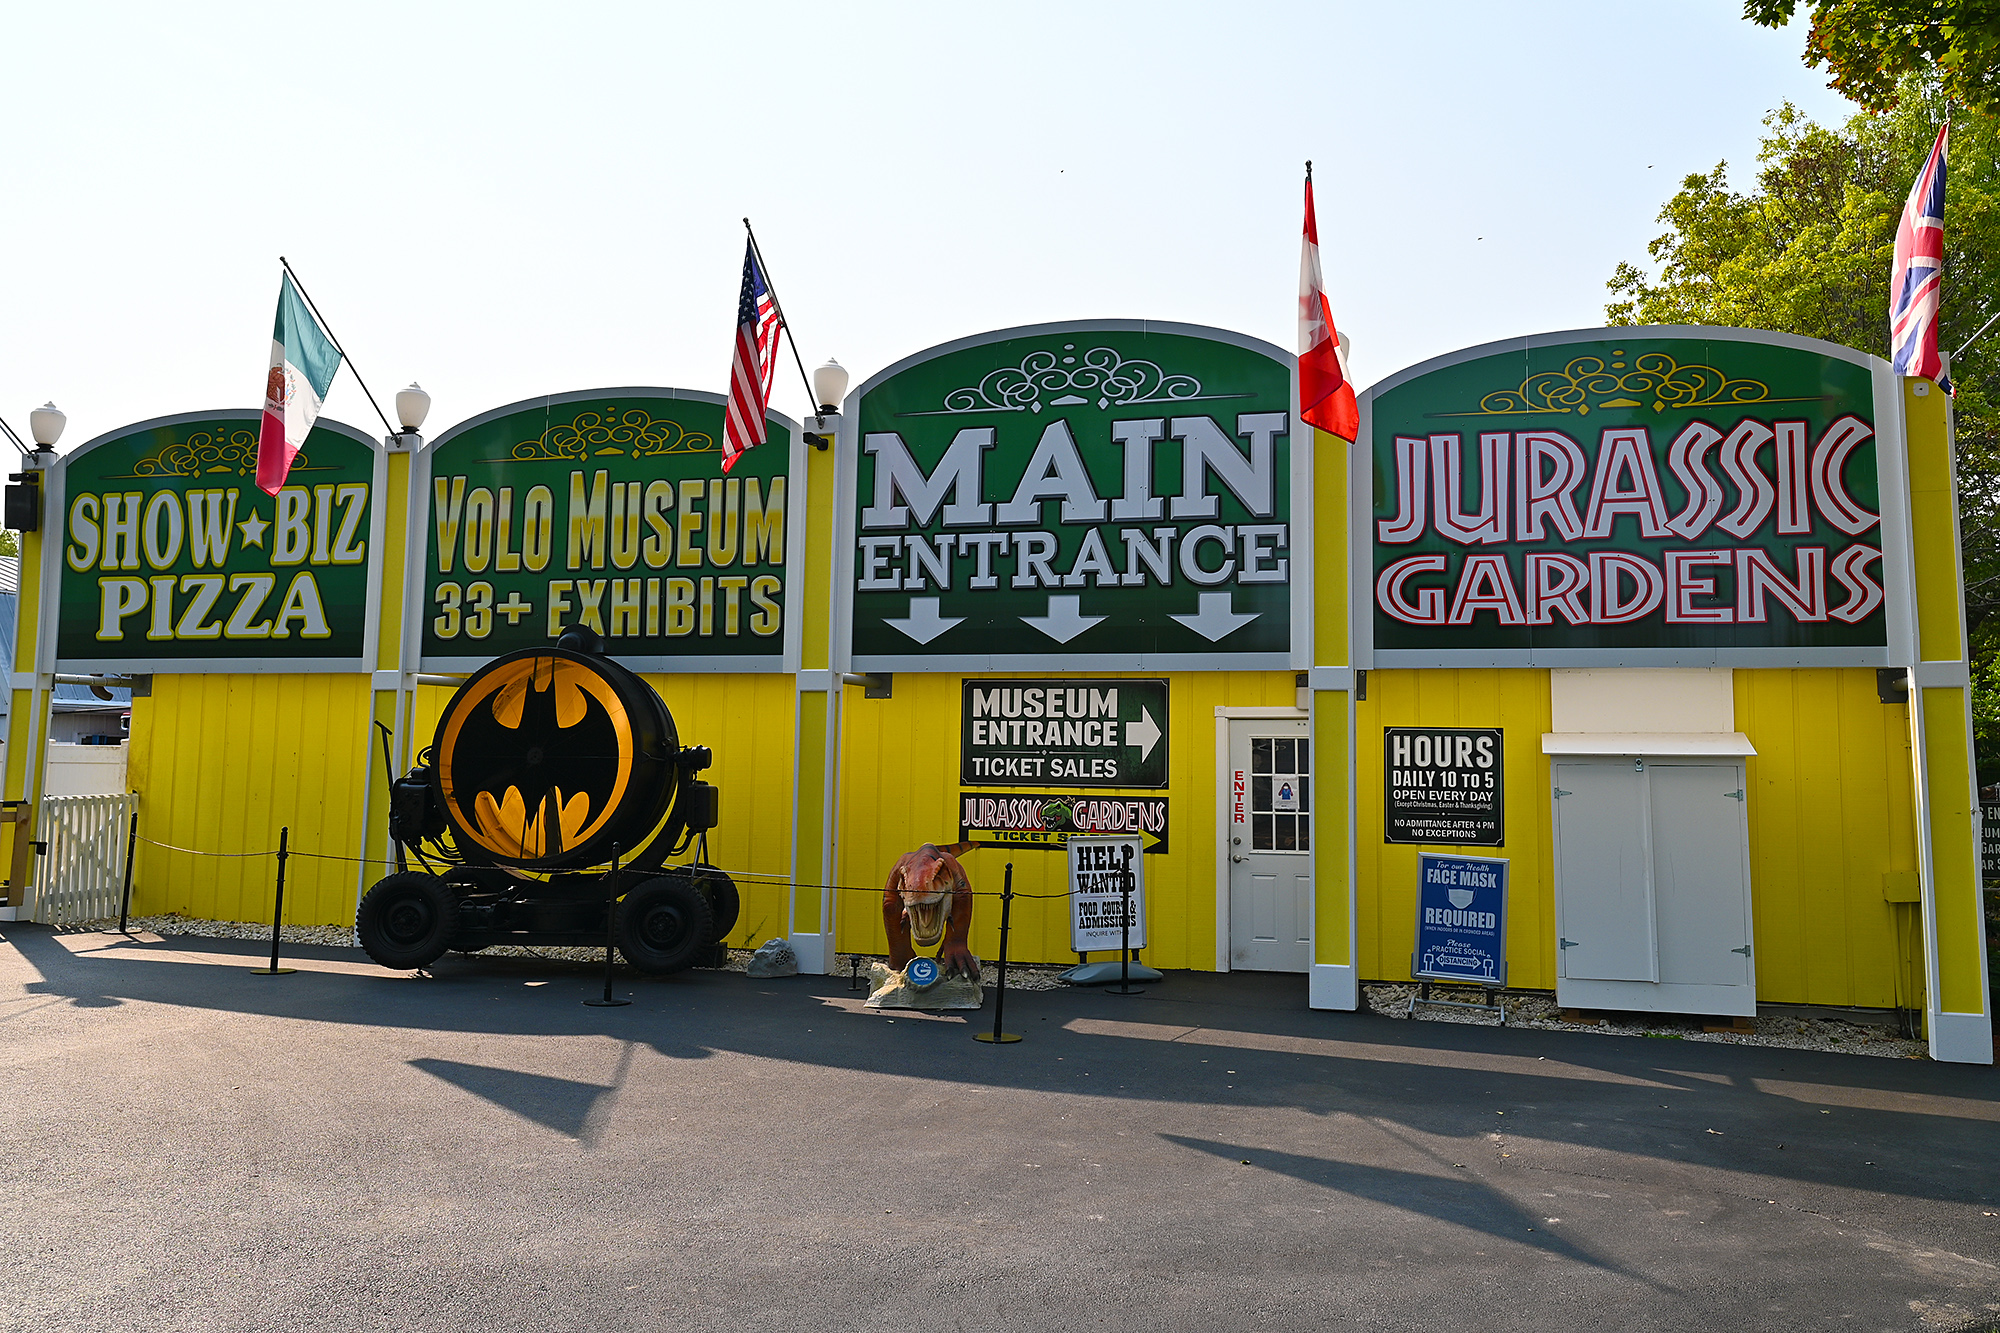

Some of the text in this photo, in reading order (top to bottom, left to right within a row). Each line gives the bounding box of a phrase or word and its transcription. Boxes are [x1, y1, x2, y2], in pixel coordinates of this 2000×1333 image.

[860, 411, 1288, 530] MAIN
[1377, 415, 1881, 546] JURASSIC
[66, 482, 370, 573] SHOW BIZ
[433, 469, 787, 574] VOLO MUSEUM
[857, 523, 1288, 591] ENTRANCE
[1376, 543, 1884, 625] GARDENS
[95, 571, 332, 642] PIZZA
[433, 574, 783, 640] 33+ EXHIBITS
[972, 688, 1118, 718] MUSEUM
[972, 720, 1118, 747] ENTRANCE
[1393, 735, 1494, 768] HOURS
[972, 757, 1118, 779] TICKET SALES
[1392, 770, 1494, 789] DAILY 10 TO 5
[1233, 770, 1245, 824] ENTER
[1393, 789, 1494, 802] OPEN EVERY DAY
[1394, 801, 1412, 809] (Except
[962, 798, 1166, 833] JURASSIC GARDENS
[1394, 819, 1495, 830] NO ADMITTANCE AFTER 4 PM
[992, 831, 1052, 842] TICKET
[1411, 828, 1477, 839] NO EXCEPTIONS
[1076, 845, 1135, 871] HELP
[1436, 860, 1450, 869] For
[1465, 862, 1490, 872] Health
[1426, 868, 1497, 888] FACE MASK
[1078, 901, 1098, 916] FOOD
[1130, 900, 1137, 914] &
[1425, 907, 1496, 929] REQUIRED
[1085, 929, 1108, 938] INQUIRE
[1447, 938, 1471, 948] Please
[1431, 944, 1486, 957] PRACTICE SOCIAL
[1439, 956, 1478, 966] DISTANCING
